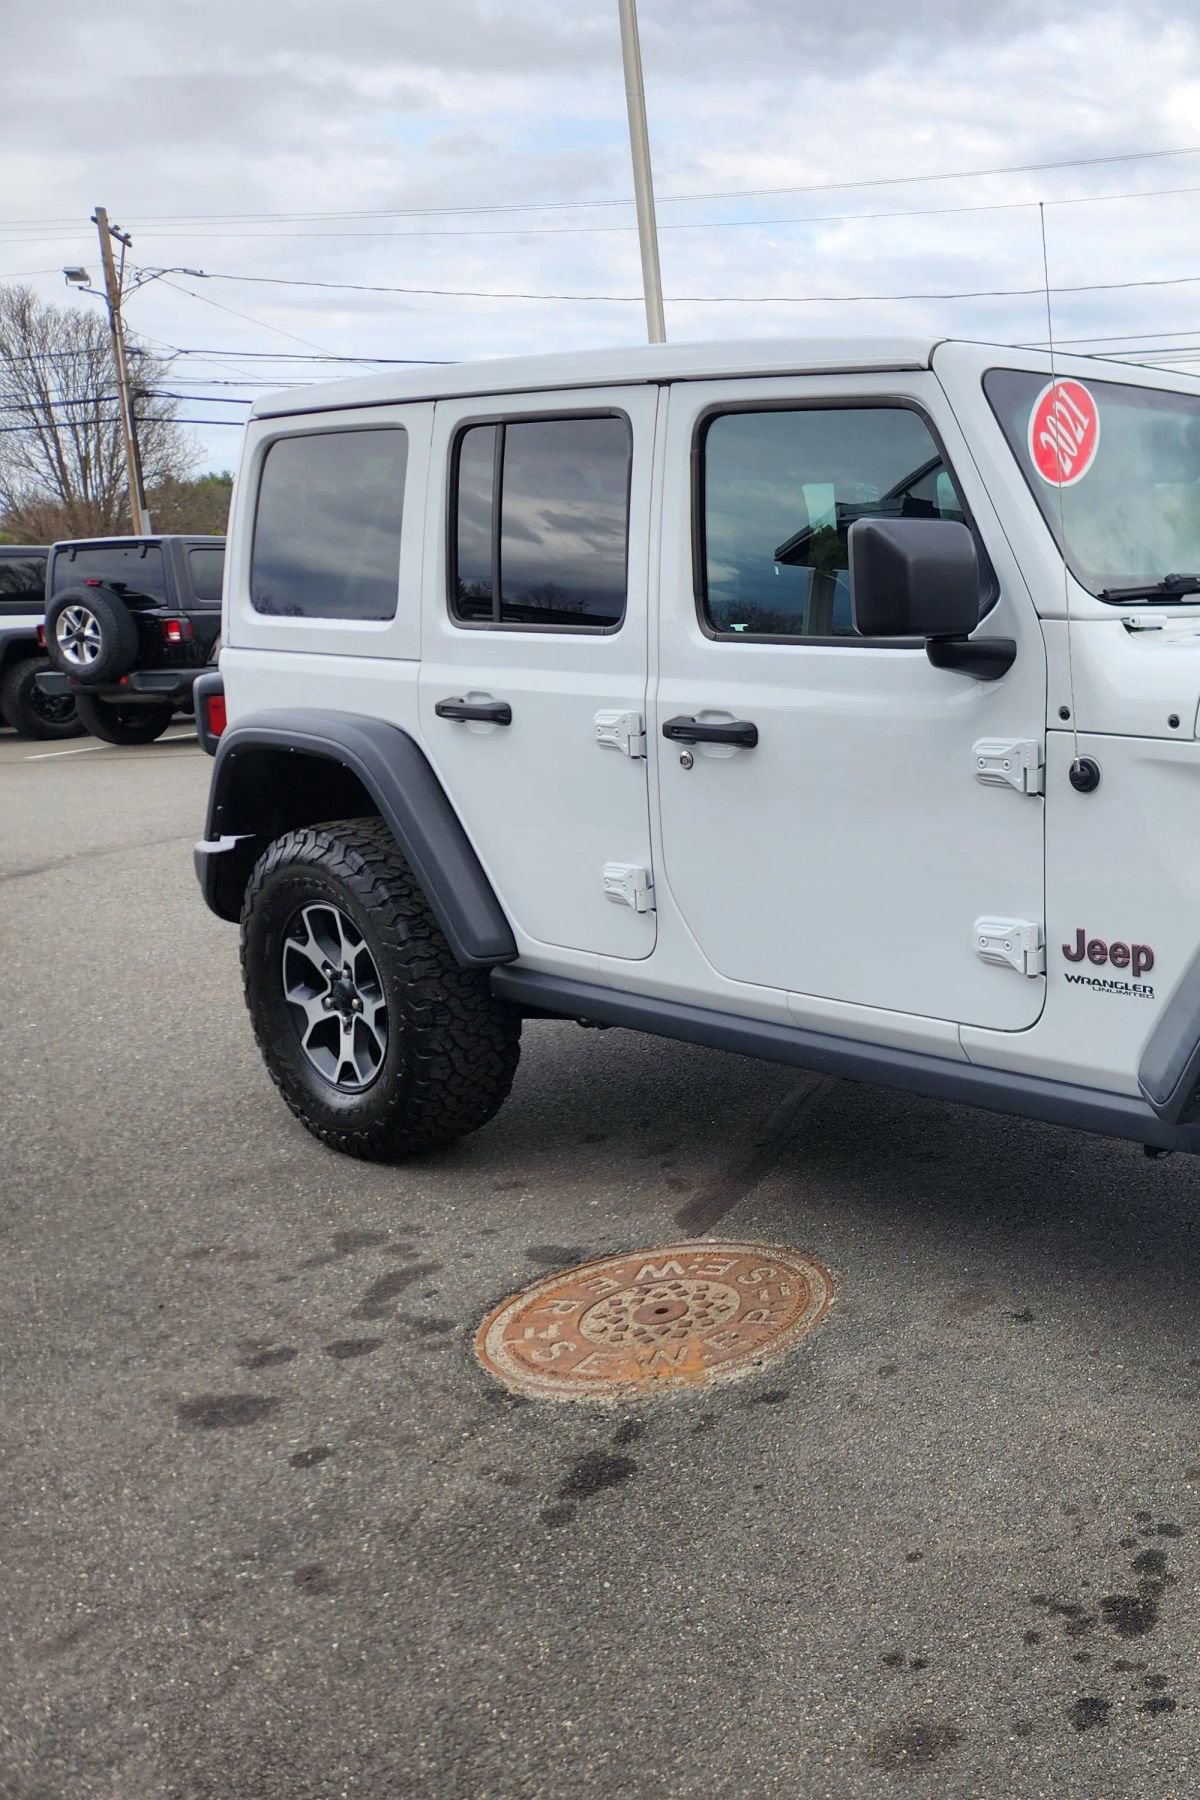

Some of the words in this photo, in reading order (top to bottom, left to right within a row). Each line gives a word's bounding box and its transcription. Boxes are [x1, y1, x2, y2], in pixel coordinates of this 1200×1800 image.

[1039, 386, 1090, 478] 2021
[1062, 927, 1155, 978] Jeep
[1064, 973, 1154, 995] WRANGLER
[1092, 986, 1155, 1000] UNLIMITED
